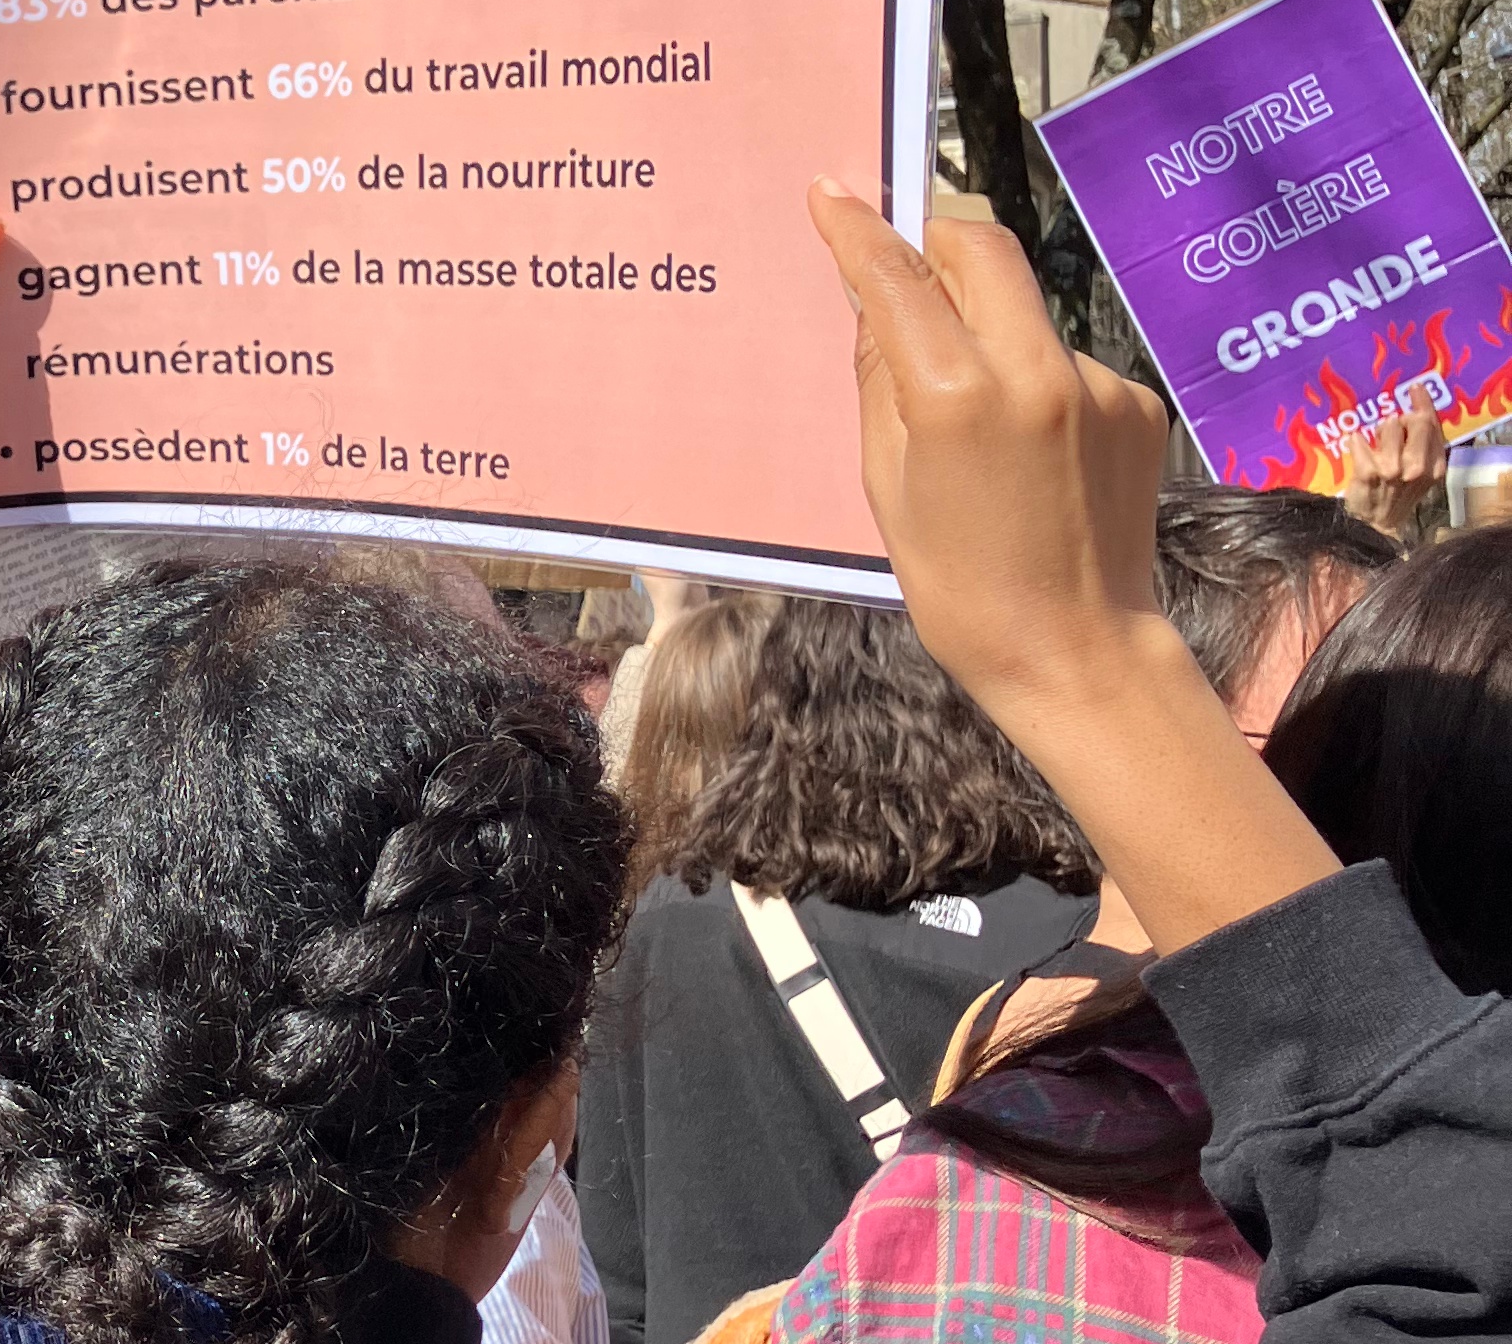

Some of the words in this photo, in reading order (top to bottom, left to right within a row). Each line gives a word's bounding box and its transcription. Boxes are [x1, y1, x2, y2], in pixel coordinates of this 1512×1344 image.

[0, 69, 254, 115] fournissent
[268, 61, 352, 99] 66%
[365, 58, 412, 94] du
[426, 48, 547, 91] travail
[563, 40, 710, 86] mondial
[1145, 72, 1334, 199] NOTRE
[10, 160, 249, 212] produisent
[263, 157, 345, 193] 50%
[358, 154, 404, 190] de
[419, 154, 447, 189] la
[463, 148, 655, 189] nourriture
[1183, 152, 1391, 284] COLÈRE
[17, 253, 202, 299] gagnent
[213, 251, 280, 285] 11%
[293, 250, 340, 284] de
[355, 249, 383, 284] la
[399, 259, 516, 287] masse
[529, 252, 638, 290] totale
[651, 253, 716, 293] des
[1215, 233, 1449, 374] GRONDE
[26, 342, 335, 379] rémunérations
[1315, 391, 1396, 444] NOUS
[34, 427, 249, 473] possèdent
[261, 432, 309, 466] 1%
[322, 434, 366, 468] de
[381, 436, 408, 471] la
[420, 443, 509, 479] terre
